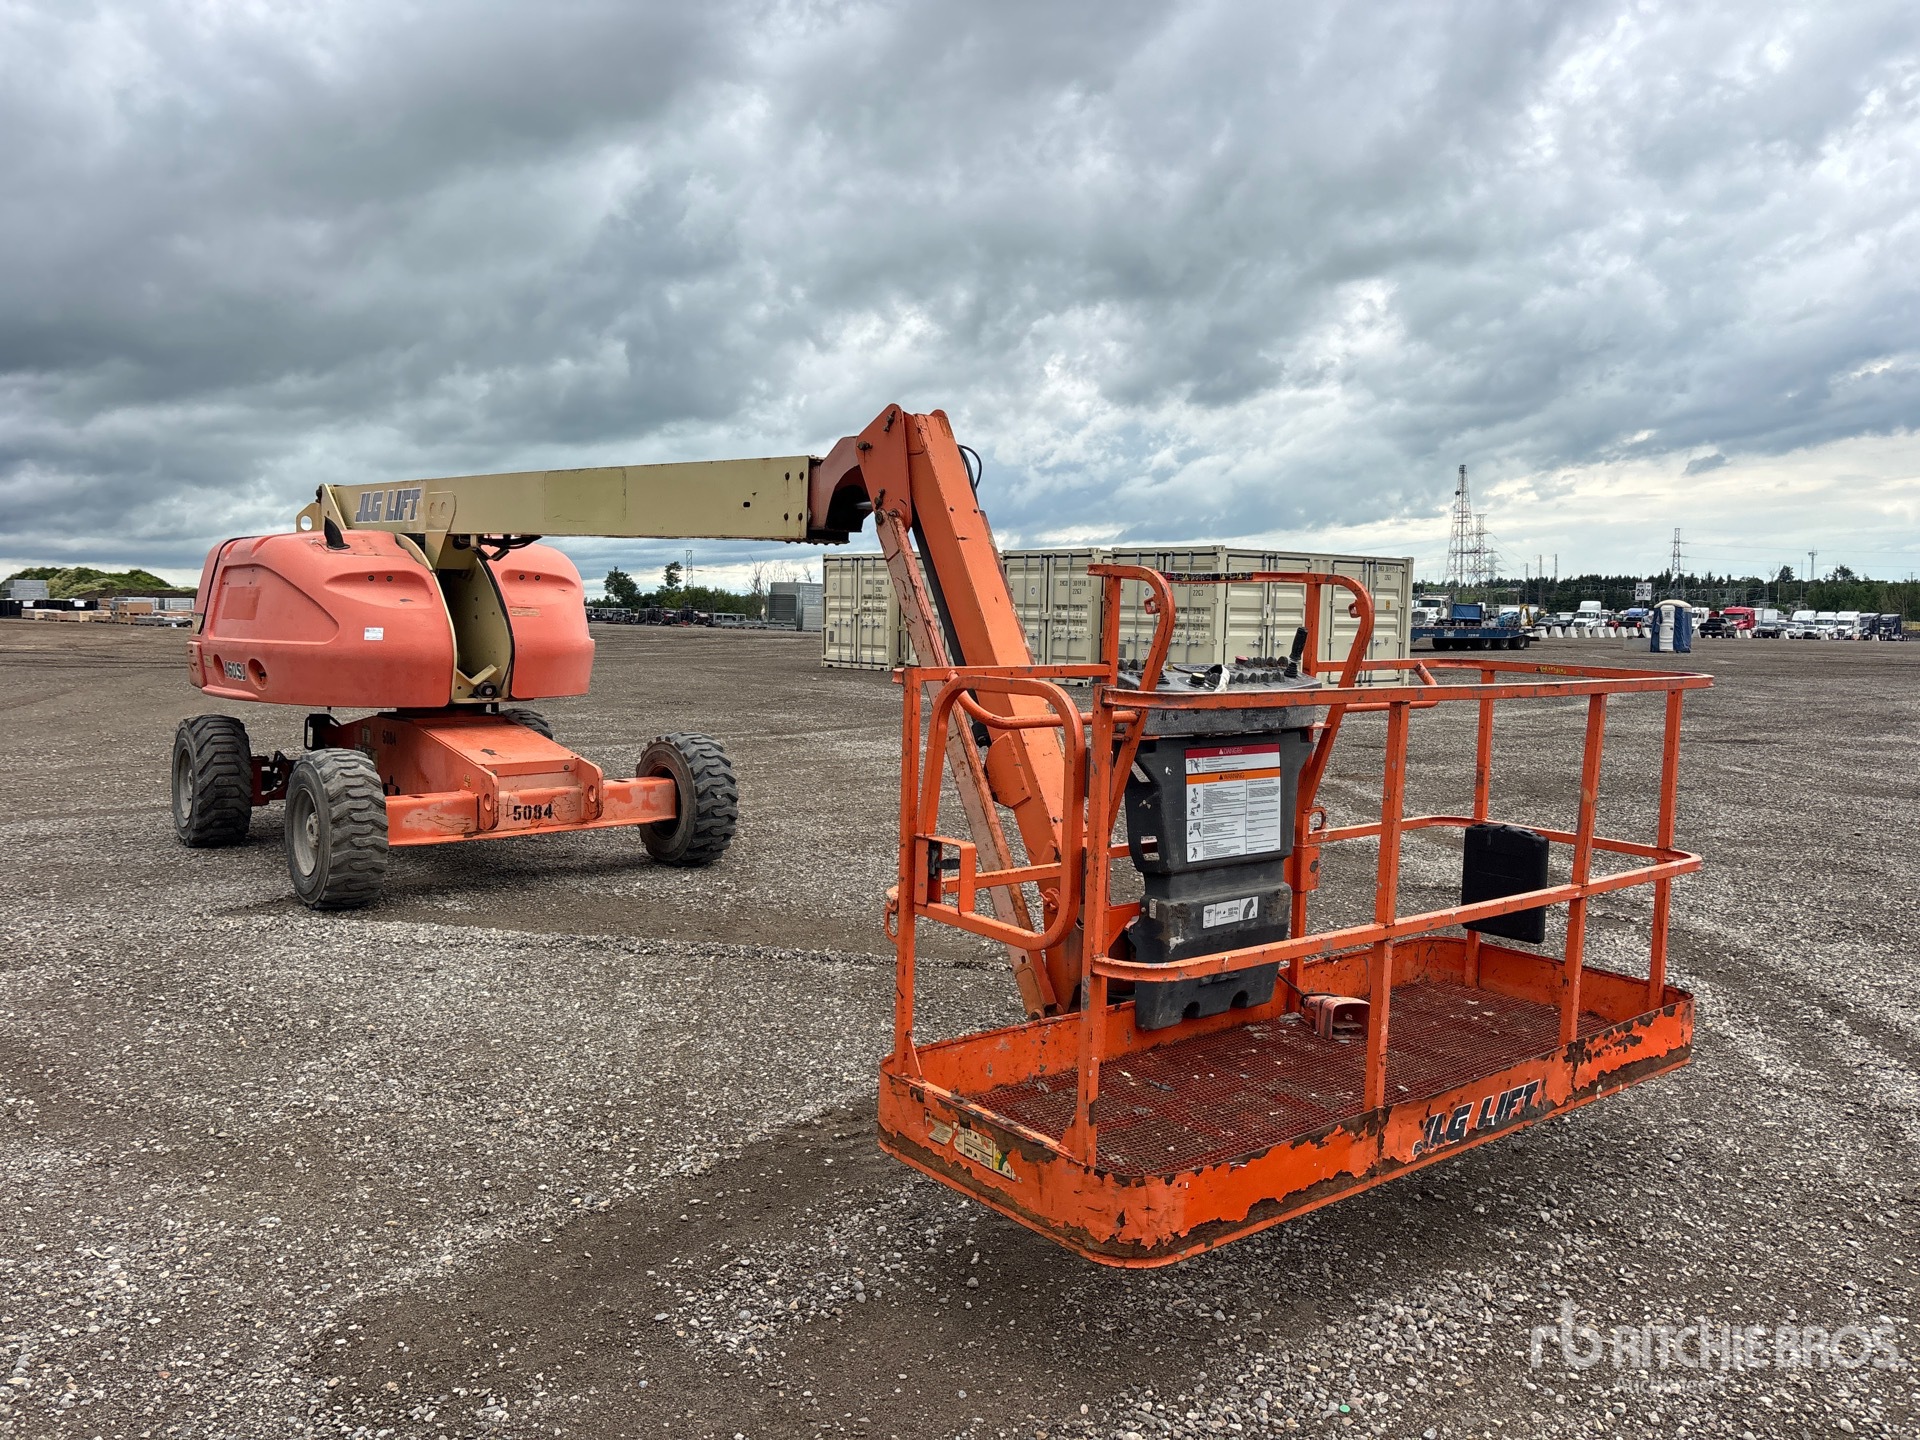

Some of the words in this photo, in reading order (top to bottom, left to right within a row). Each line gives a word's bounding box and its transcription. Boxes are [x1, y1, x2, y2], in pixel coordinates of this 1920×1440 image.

[355, 490, 384, 523] JLG
[384, 488, 422, 522] LIFT
[1636, 588, 1645, 597] 29
[1223, 746, 1243, 755] DANGER
[1223, 771, 1245, 780] WARNING
[513, 803, 553, 821] 5084
[1475, 1079, 1540, 1130] LIFT
